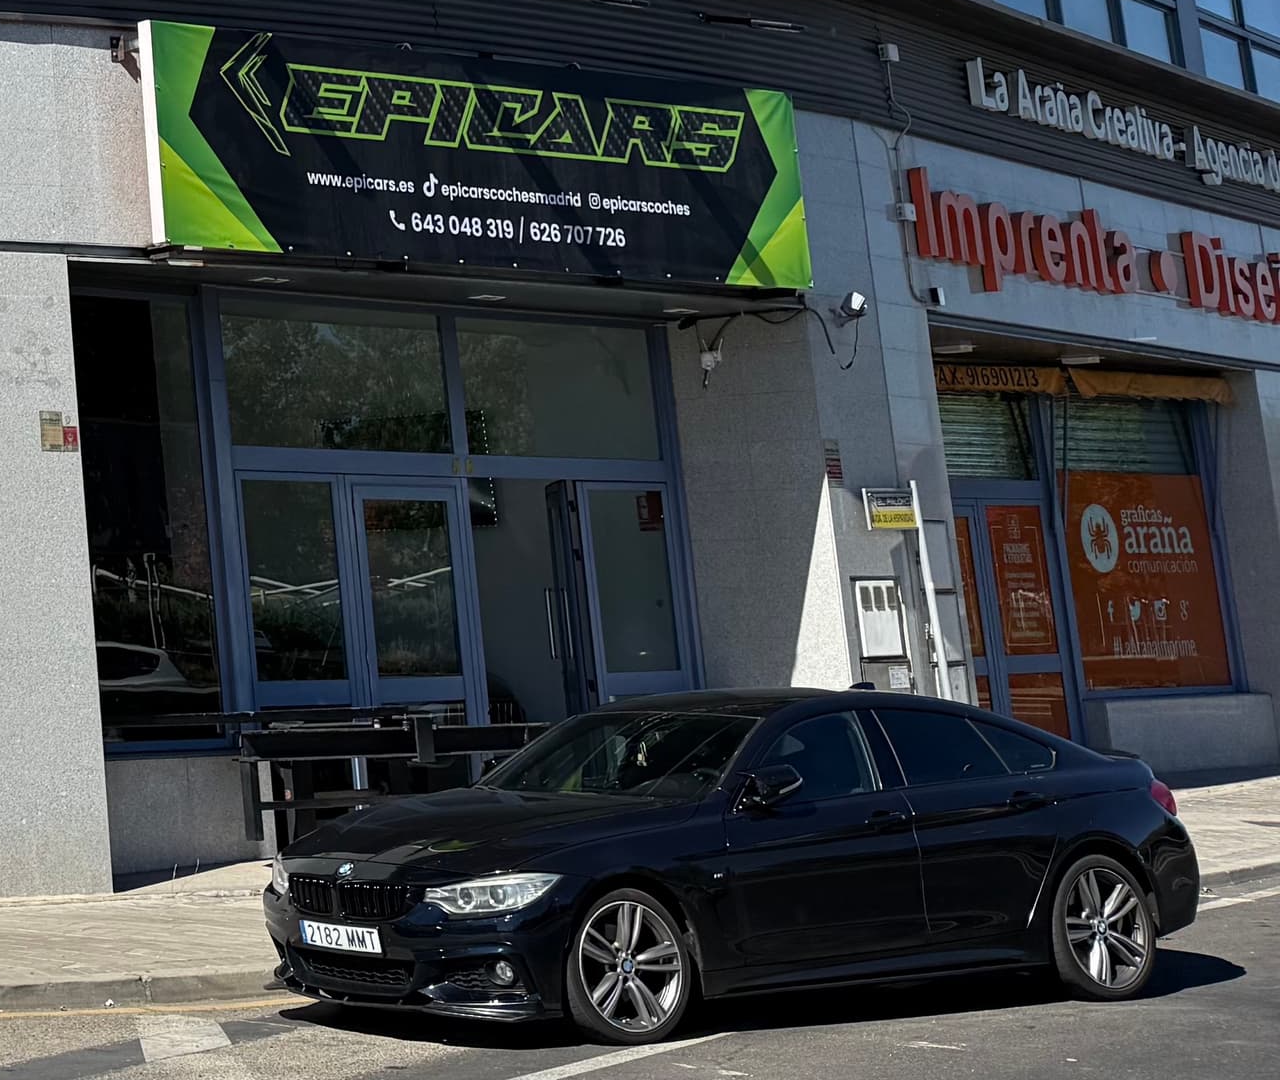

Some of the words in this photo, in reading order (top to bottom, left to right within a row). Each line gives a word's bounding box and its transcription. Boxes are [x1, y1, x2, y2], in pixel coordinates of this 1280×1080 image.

[281, 63, 745, 172] EPICARS
[970, 57, 1009, 111] La
[1012, 68, 1085, 133] Araña
[1087, 91, 1175, 161] Creativa
[1188, 125, 1266, 186] Agencia
[1266, 149, 1280, 193] d
[306, 171, 415, 196] www.epicars.es
[441, 181, 582, 208] epicarscochesmadrid
[602, 195, 691, 217] epicarscoches
[410, 211, 445, 234] 643
[448, 215, 483, 237] 048
[486, 218, 515, 240] 319
[529, 221, 561, 244] 626
[563, 223, 594, 246] 707
[596, 226, 627, 248] 726
[910, 167, 1140, 292] Imprenta
[1183, 231, 1280, 324] Dise
[935, 365, 965, 386] AX:
[1124, 516, 1194, 554] araña
[307, 923, 343, 947] 2182
[345, 928, 376, 951] MMT
